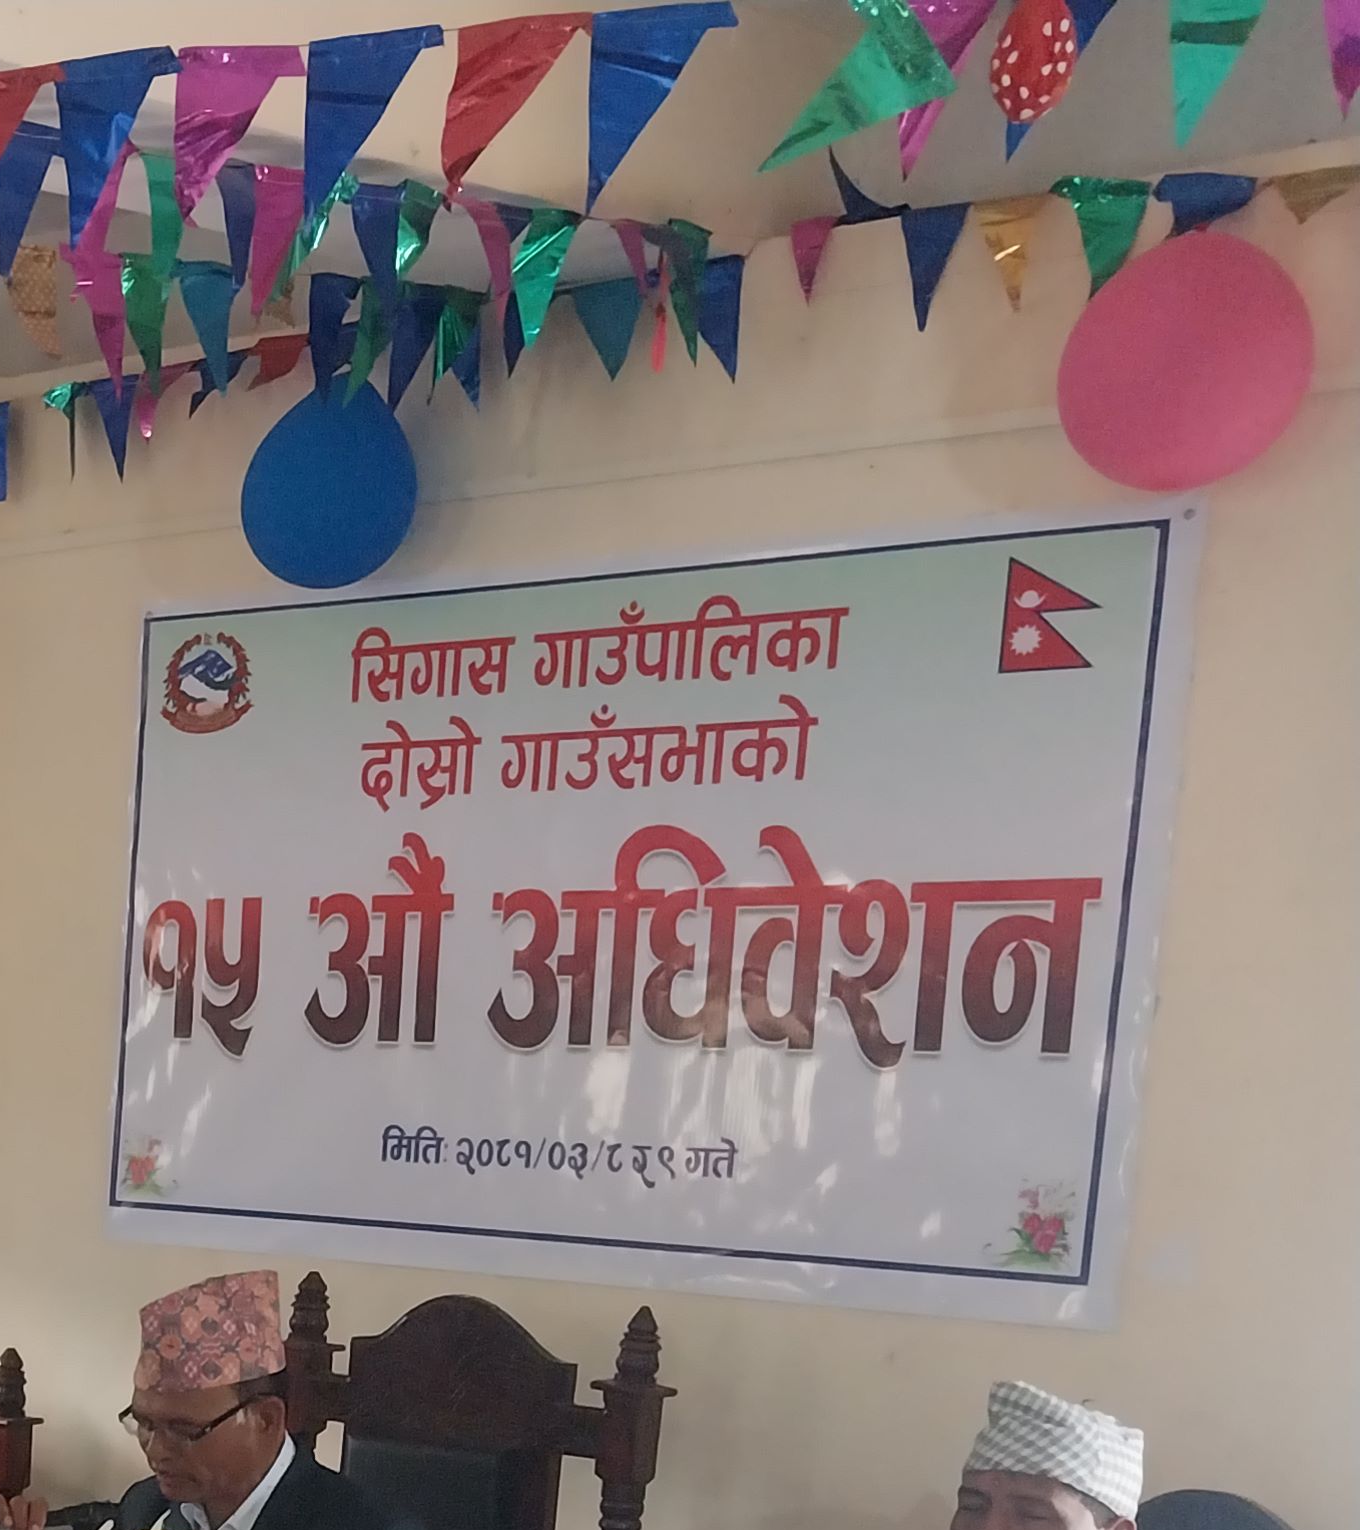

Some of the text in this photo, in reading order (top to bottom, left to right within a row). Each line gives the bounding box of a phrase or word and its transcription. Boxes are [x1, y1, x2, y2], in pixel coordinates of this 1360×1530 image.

[351, 594, 850, 703] सिगास गाउँपालिका
[360, 694, 819, 812] दोस्रो गाउँसभाको
[141, 896, 263, 1056] १५
[487, 824, 1103, 1069] अधिवेशन
[684, 1137, 739, 1179] गते
